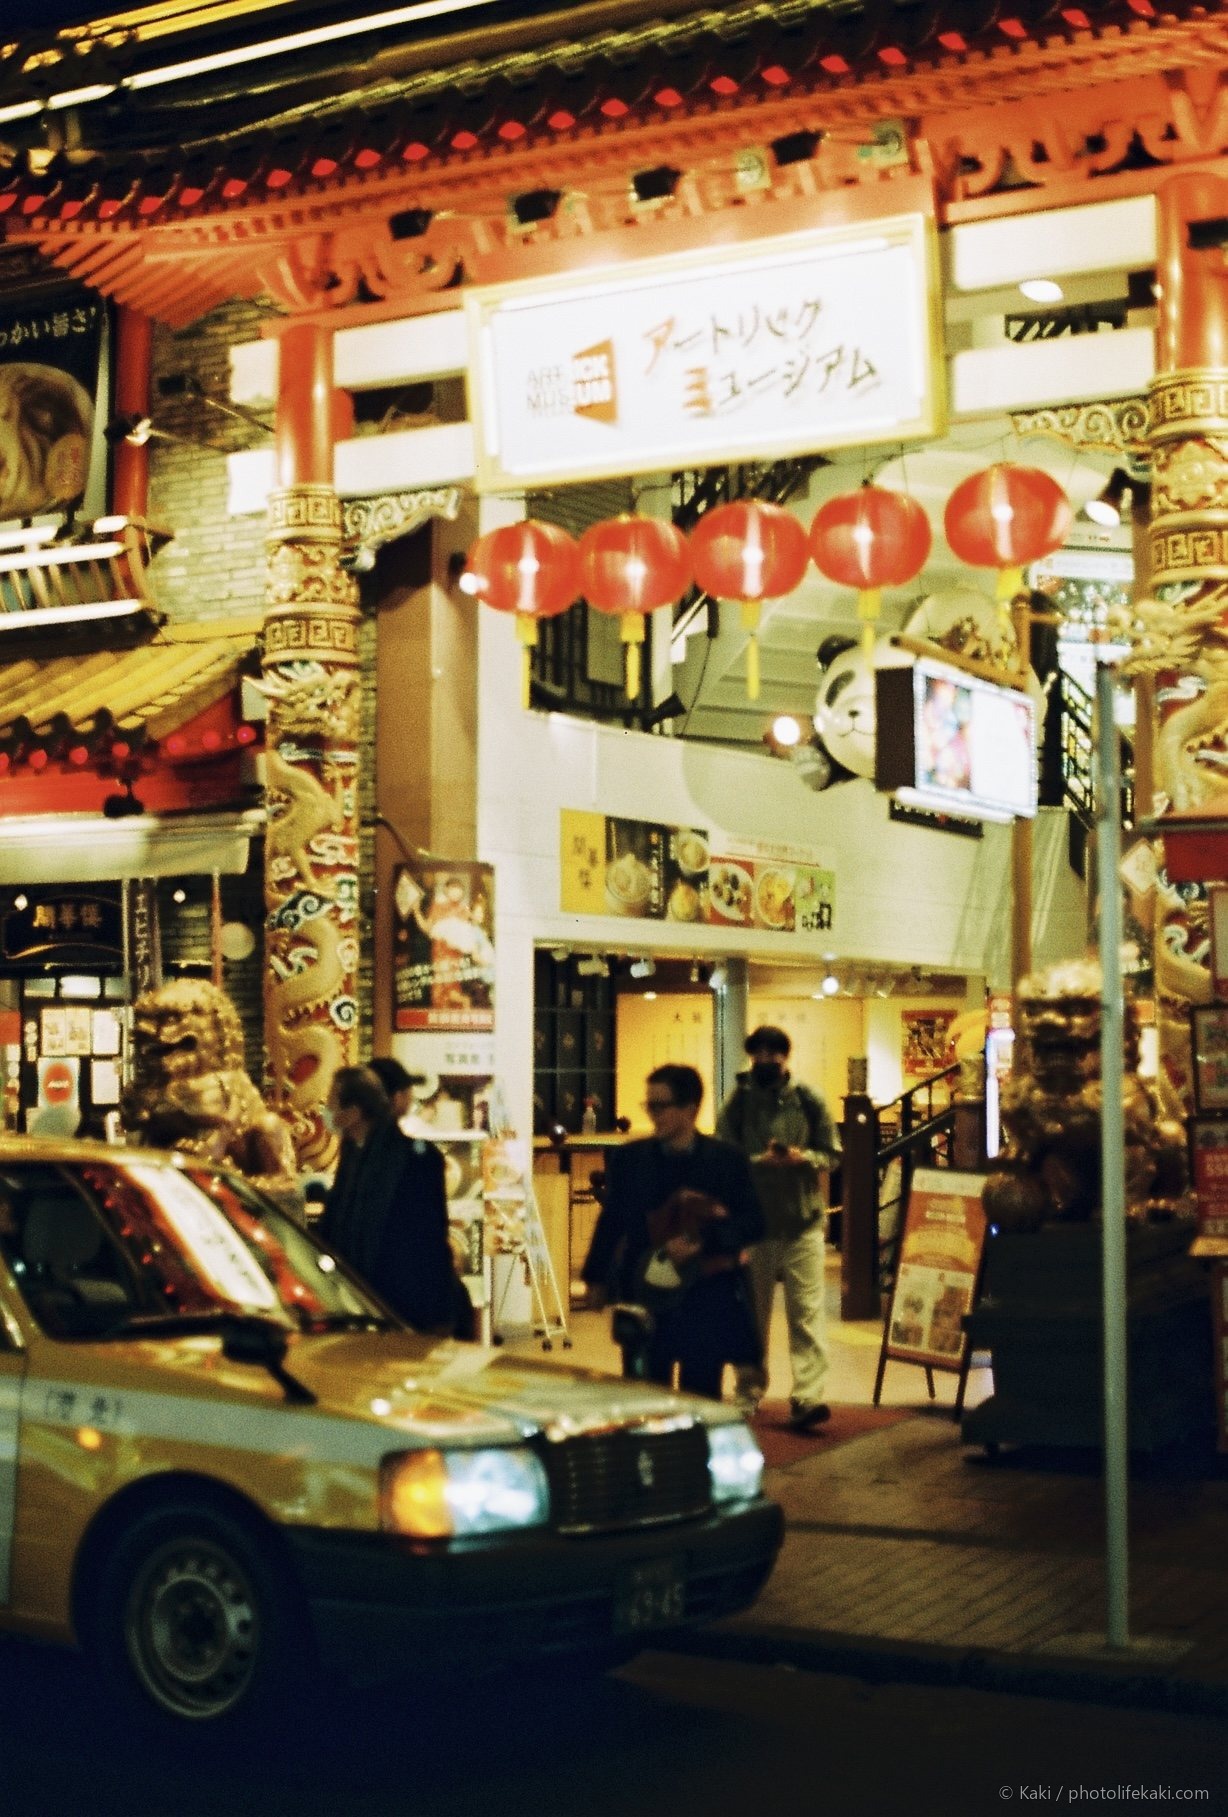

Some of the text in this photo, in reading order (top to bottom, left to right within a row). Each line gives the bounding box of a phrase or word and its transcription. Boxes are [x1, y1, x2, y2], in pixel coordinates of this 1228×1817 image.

[681, 343, 879, 415] ミュージアム
